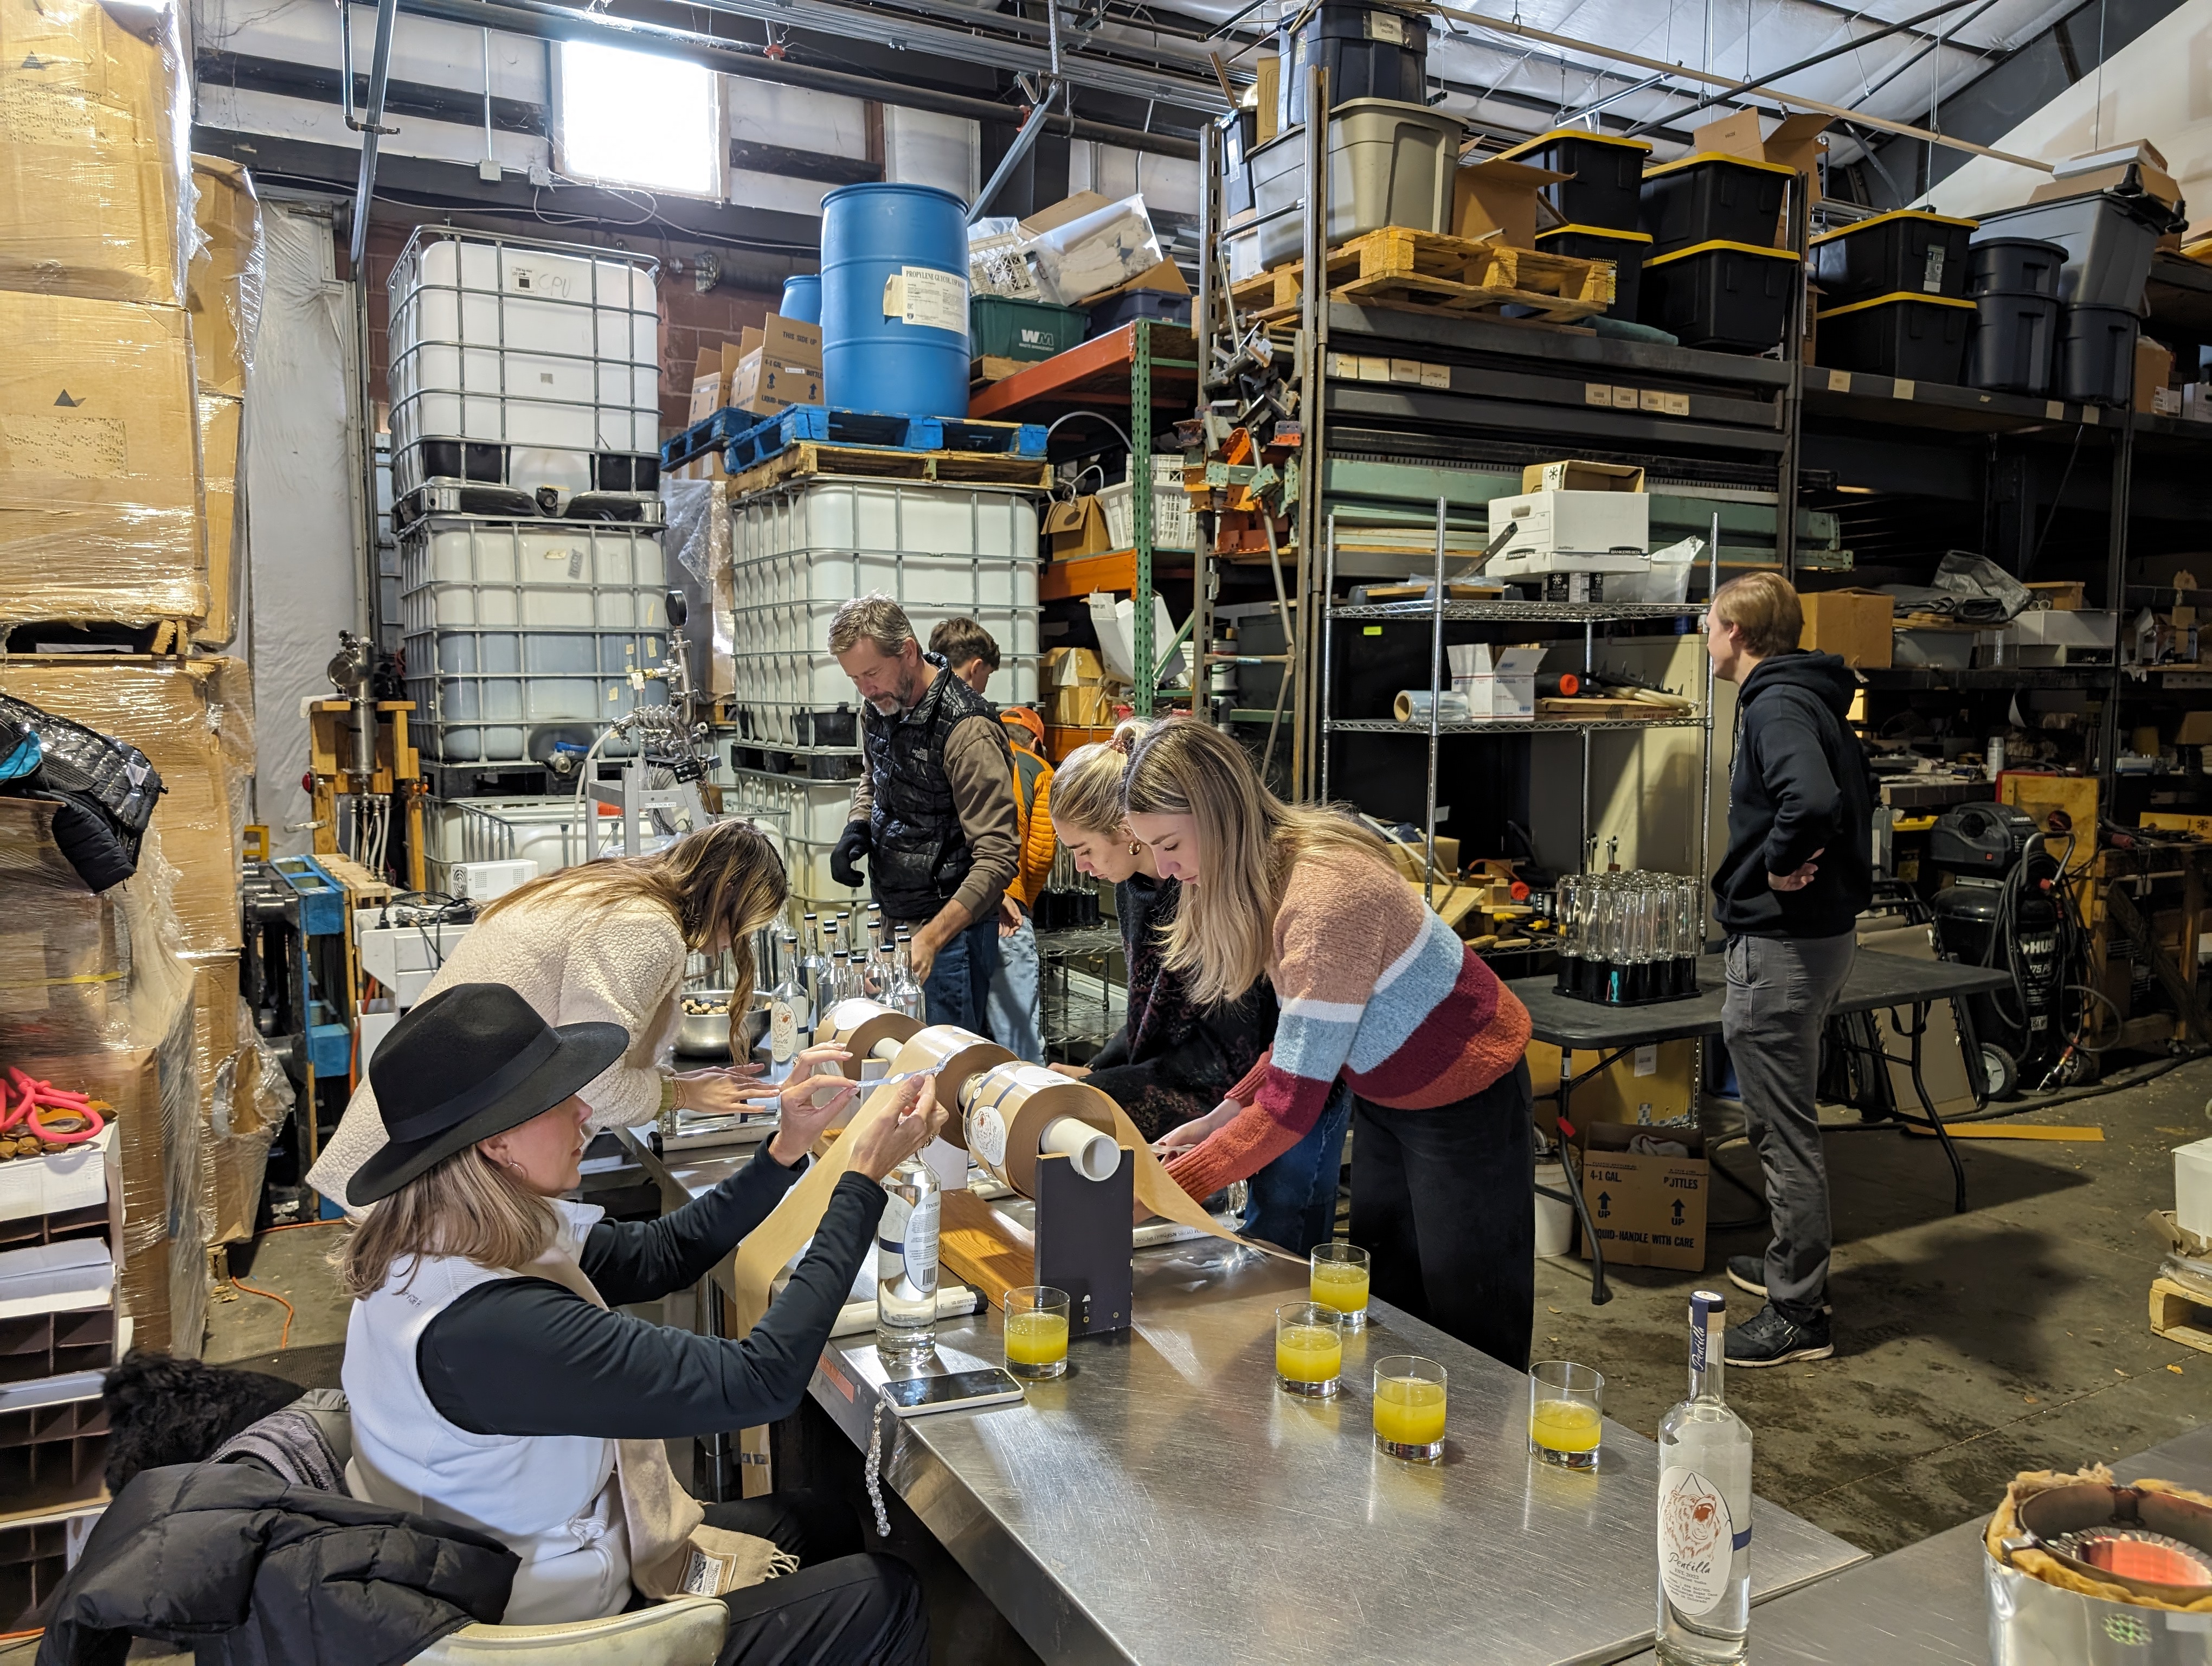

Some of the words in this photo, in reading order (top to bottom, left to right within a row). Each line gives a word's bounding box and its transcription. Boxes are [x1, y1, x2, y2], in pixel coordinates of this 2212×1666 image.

[906, 270, 934, 280] PROPYLENE
[783, 331, 794, 340] THIS
[796, 335, 808, 344] SIDE
[1021, 329, 1054, 346] WM
[2030, 939, 2055, 954] HUS
[1590, 1170, 1602, 1181] 4-1
[1605, 1171, 1622, 1182] GAL.
[1598, 1210, 1611, 1218] UP
[1671, 1218, 1685, 1226] UP
[1595, 1228, 1648, 1244] QUID-HANDLE
[1652, 1234, 1671, 1246] WITH
[1674, 1237, 1694, 1248] CARE
[1692, 1325, 1705, 1370] Pentilla
[1668, 1552, 1711, 1574] Pentilla
[709, 1564, 720, 1594] TRADITIONS
